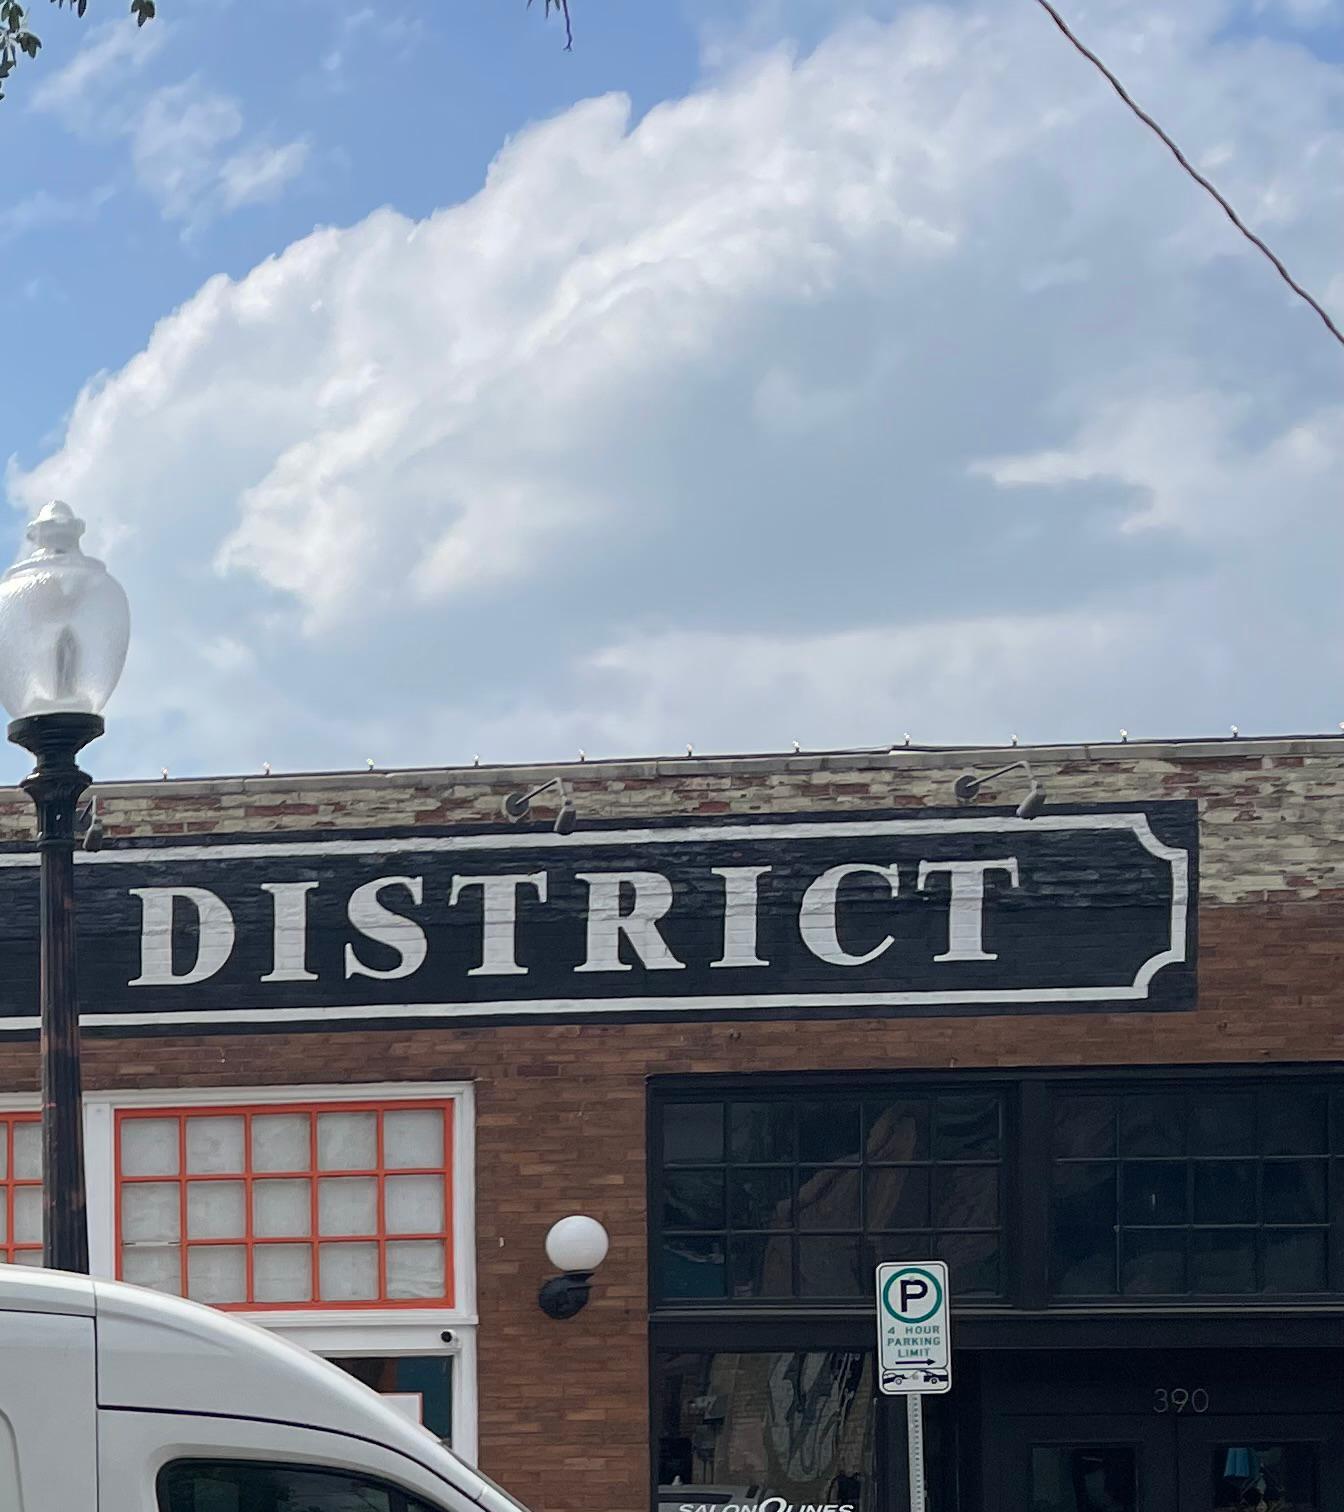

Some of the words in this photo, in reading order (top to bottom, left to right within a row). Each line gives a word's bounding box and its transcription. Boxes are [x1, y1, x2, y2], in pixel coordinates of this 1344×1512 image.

[127, 857, 1018, 988] DISTRICT
[901, 1279, 928, 1312] P
[887, 1326, 895, 1335] 4
[905, 1325, 940, 1335] HOUR
[887, 1337, 941, 1347] PARKING
[897, 1348, 930, 1359] LIMIT
[1153, 1388, 1209, 1413] 390
